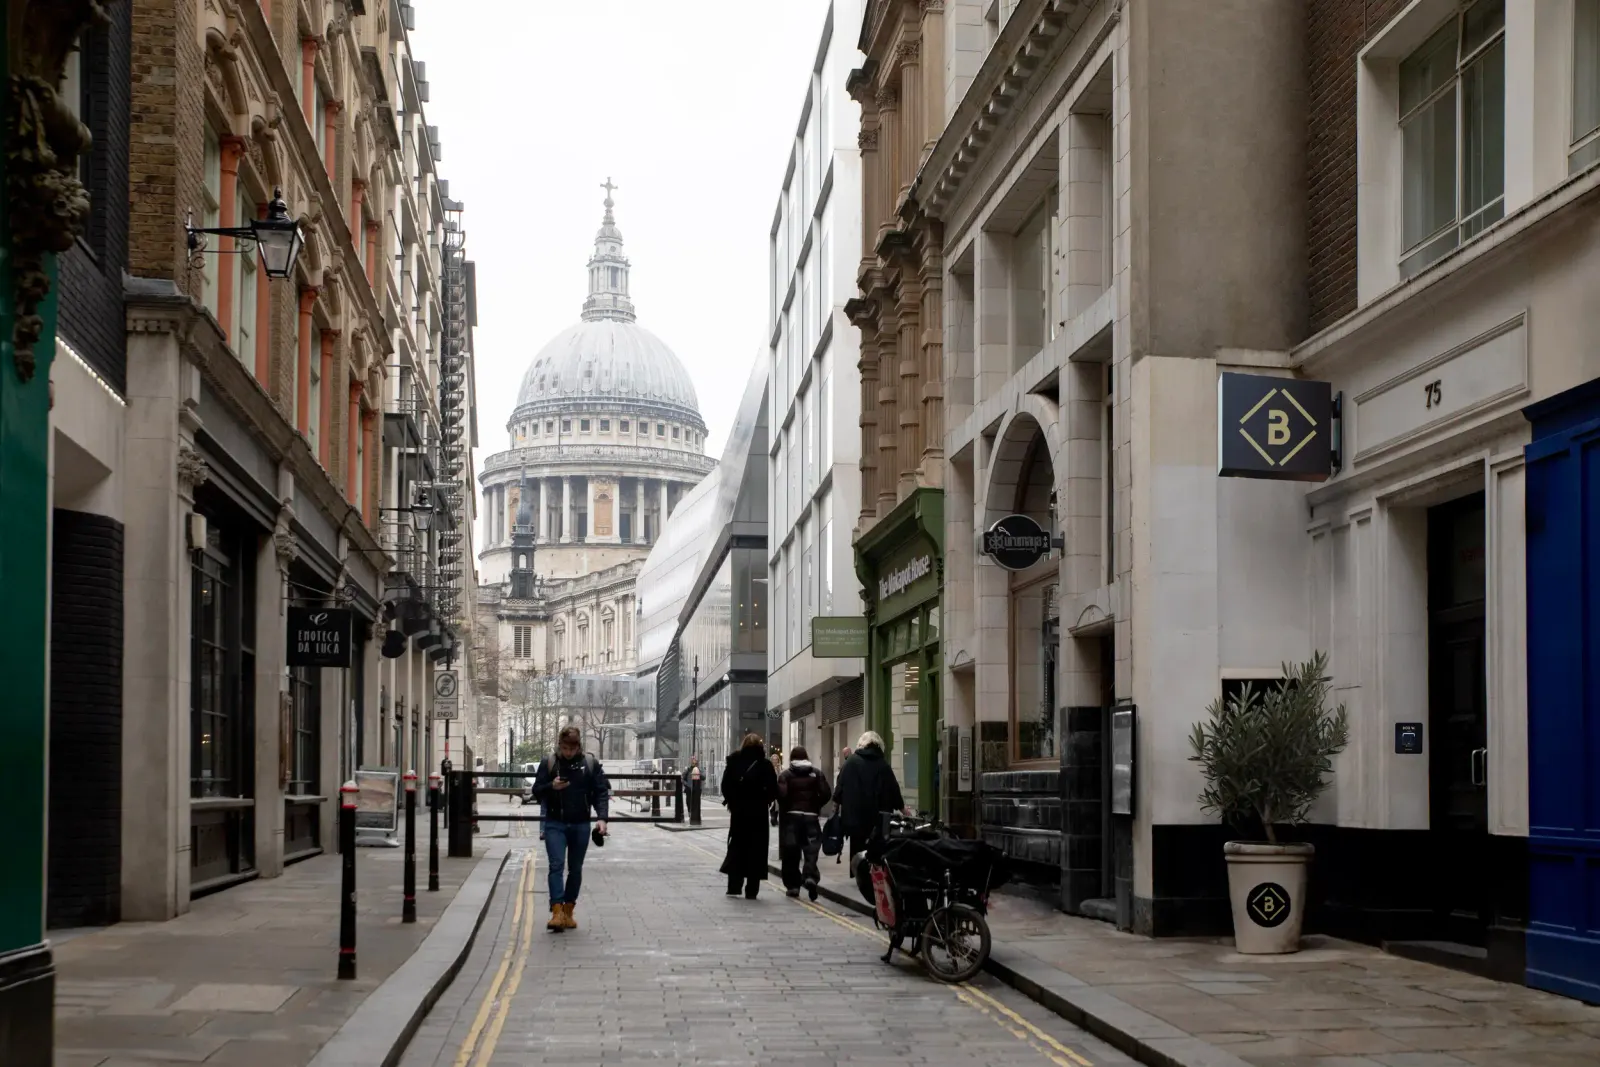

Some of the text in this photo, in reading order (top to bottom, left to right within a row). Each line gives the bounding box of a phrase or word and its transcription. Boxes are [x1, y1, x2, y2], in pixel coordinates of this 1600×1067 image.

[1424, 379, 1442, 409] 75
[1268, 409, 1291, 446] B
[298, 630, 340, 642] ENOTECA
[297, 642, 340, 654] DA LUCA
[1264, 896, 1275, 912] B
